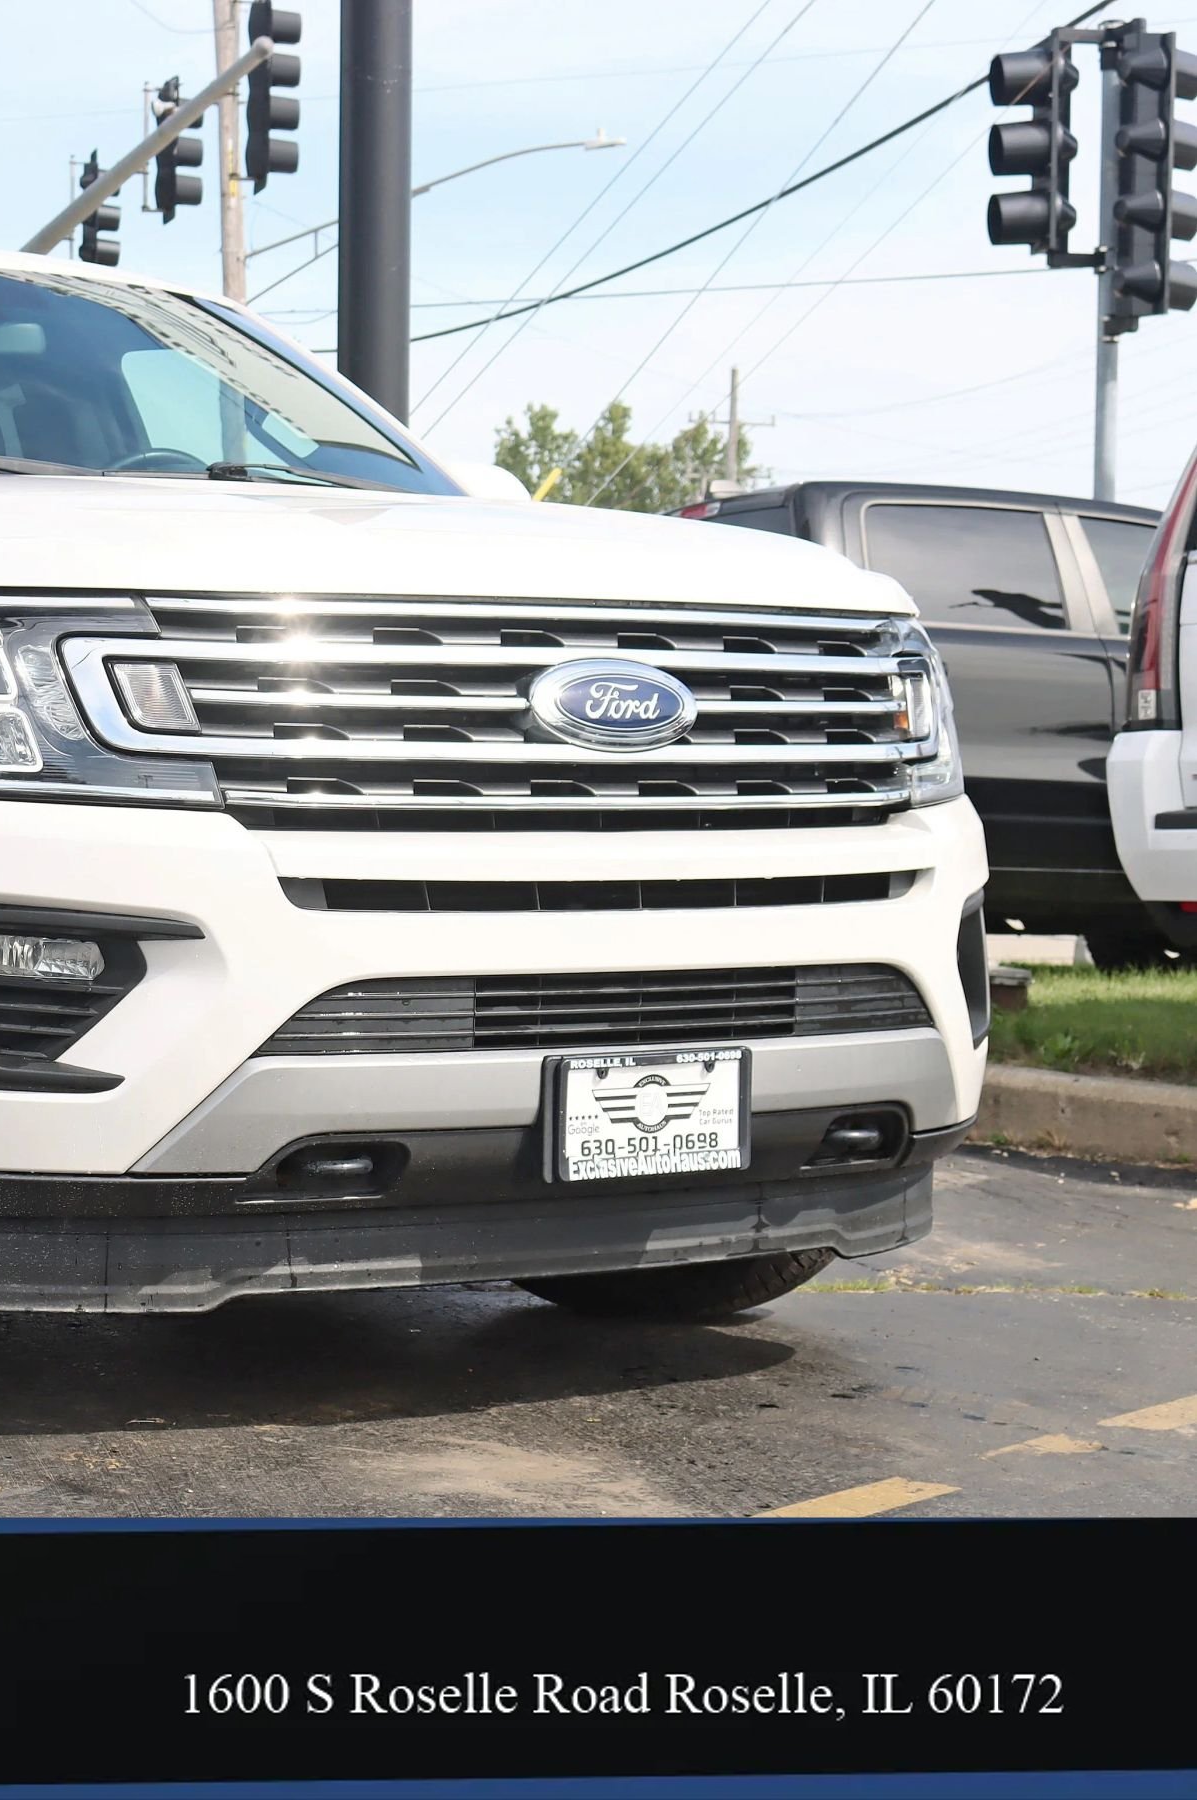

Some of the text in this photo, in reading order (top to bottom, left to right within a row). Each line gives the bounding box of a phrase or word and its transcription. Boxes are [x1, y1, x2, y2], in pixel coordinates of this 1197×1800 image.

[585, 681, 661, 719] Ford
[570, 1056, 636, 1069] ROSELLE, IL
[676, 1050, 742, 1063] 630-501-0698
[568, 1122, 600, 1136] Google
[581, 1132, 719, 1157] 630-501-0698
[569, 1149, 741, 1181] ExclusiveAutoHaus.com
